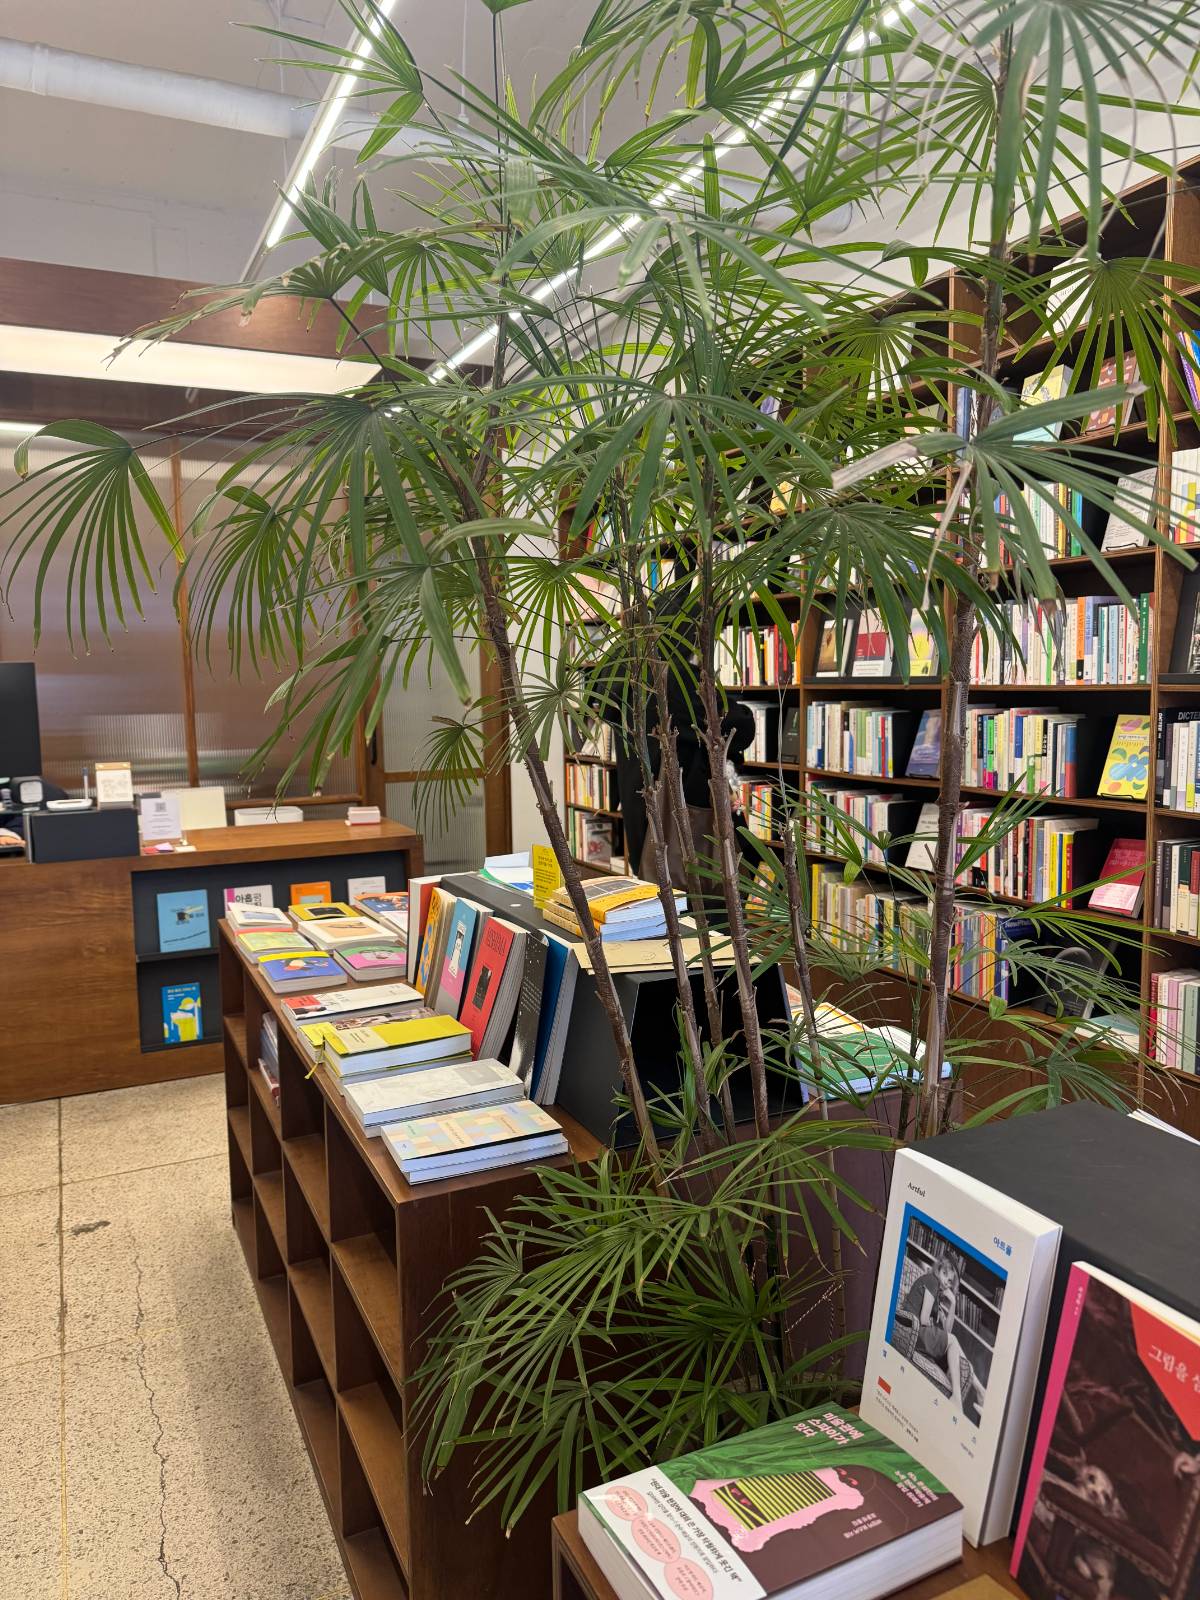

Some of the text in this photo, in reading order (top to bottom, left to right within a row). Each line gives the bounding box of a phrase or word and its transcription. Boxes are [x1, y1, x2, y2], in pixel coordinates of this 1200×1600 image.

[907, 1182, 926, 1197] Artful
[993, 1236, 1013, 1256] 아트풀
[1148, 1345, 1189, 1383] 그림을
[793, 1423, 818, 1437] 있다
[807, 1419, 850, 1444] 스파이가
[823, 1412, 865, 1440] 미술관에
